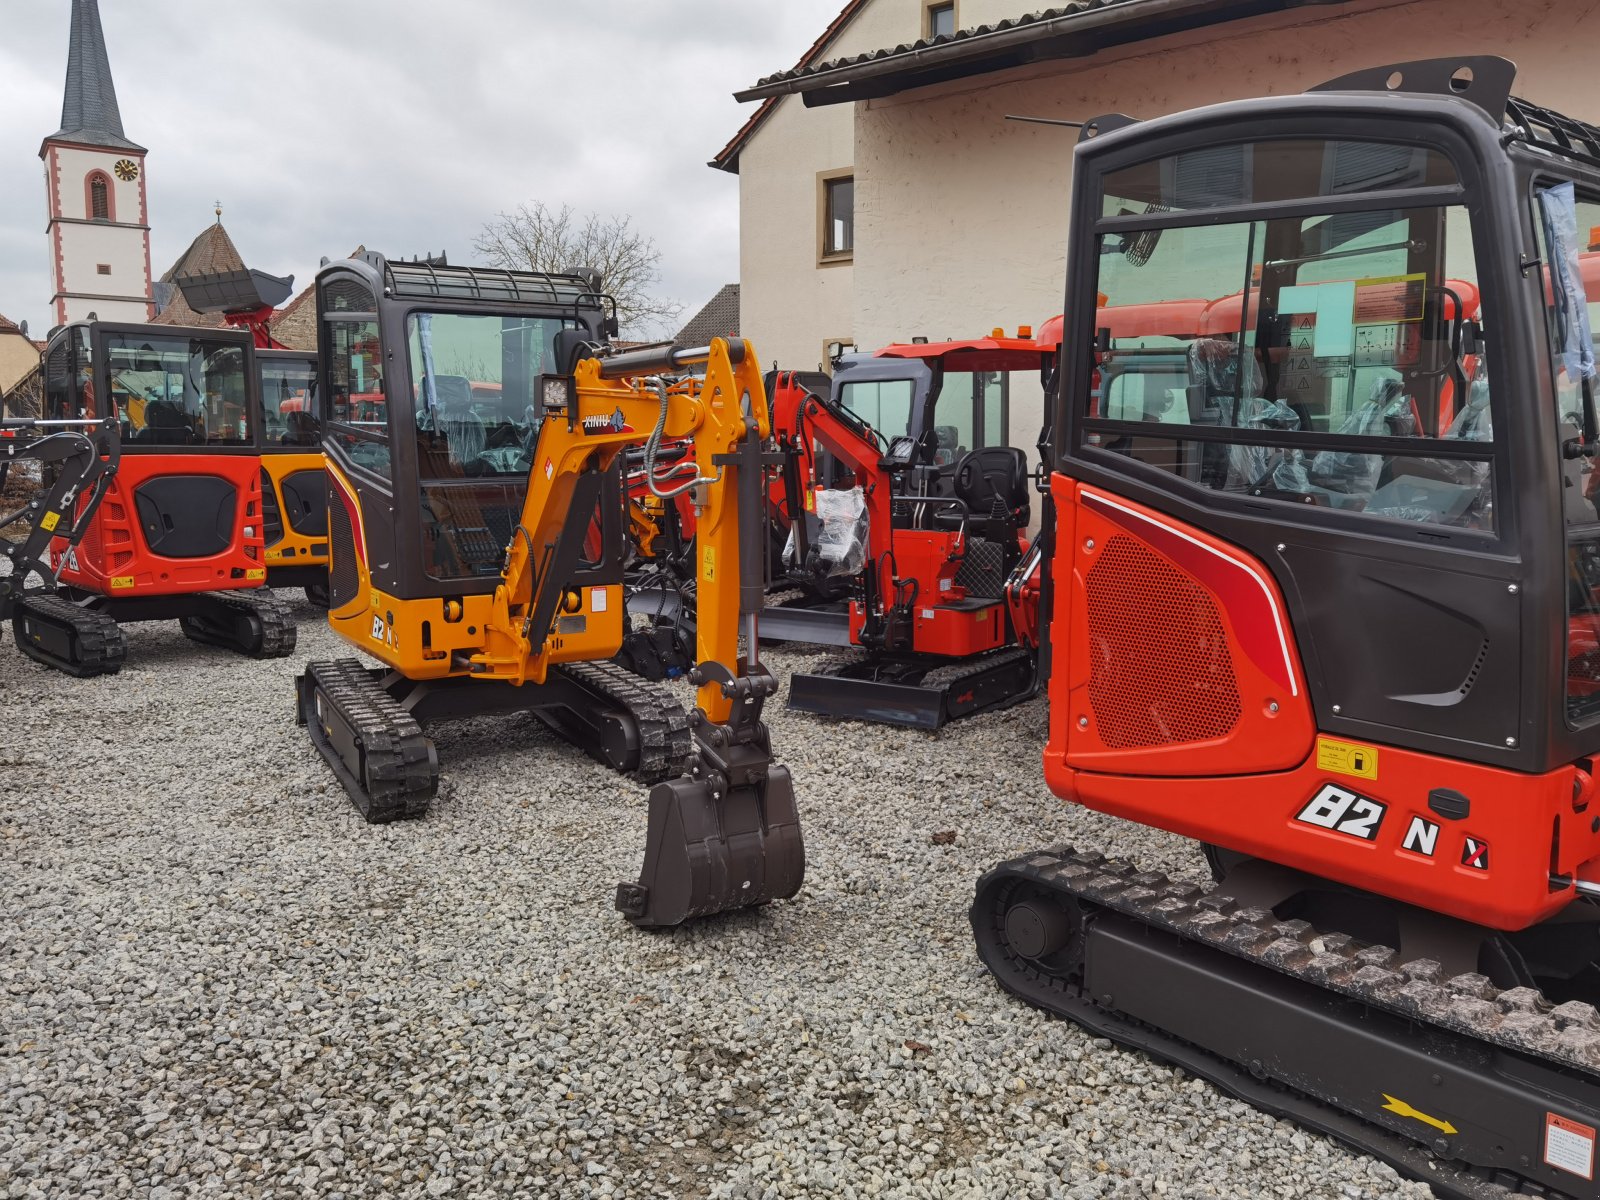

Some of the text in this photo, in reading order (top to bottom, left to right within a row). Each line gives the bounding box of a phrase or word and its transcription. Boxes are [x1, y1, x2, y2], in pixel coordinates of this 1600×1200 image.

[584, 414, 609, 428] XINIU
[1402, 816, 1439, 856] N
[1464, 838, 1487, 868] X
